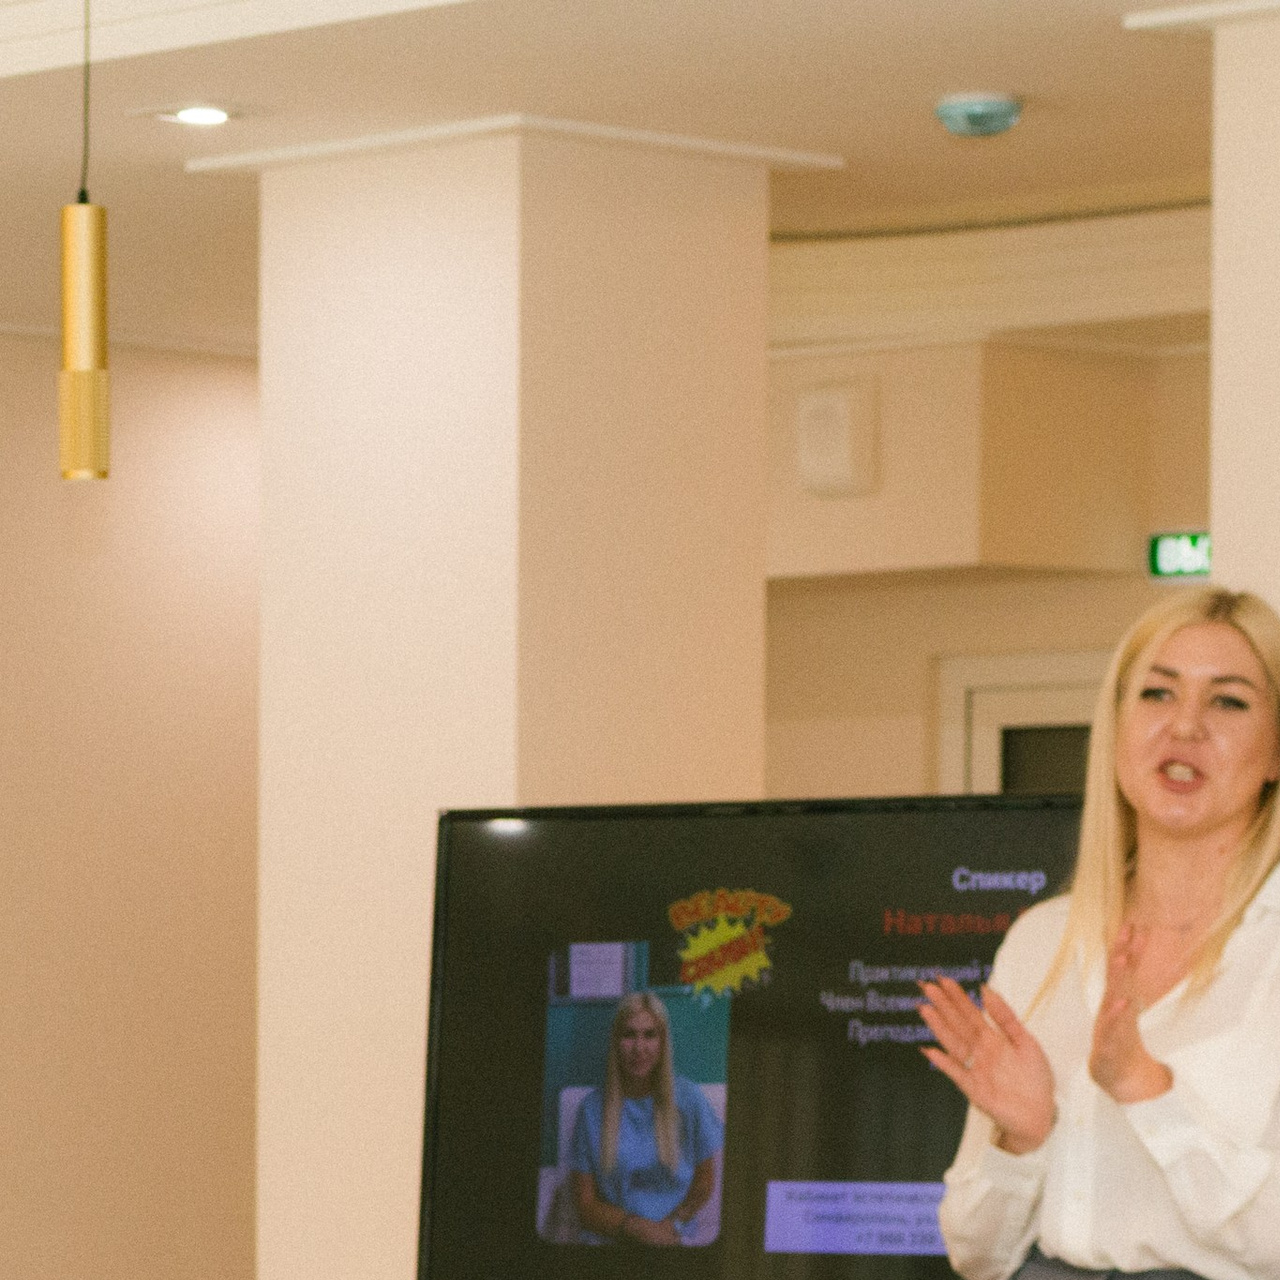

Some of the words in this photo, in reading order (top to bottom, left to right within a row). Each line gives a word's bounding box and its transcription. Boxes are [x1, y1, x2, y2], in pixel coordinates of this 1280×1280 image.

[1158, 536, 1210, 573] ВЫ
[952, 867, 1047, 895] Спикер
[883, 909, 1012, 935] Наталья
